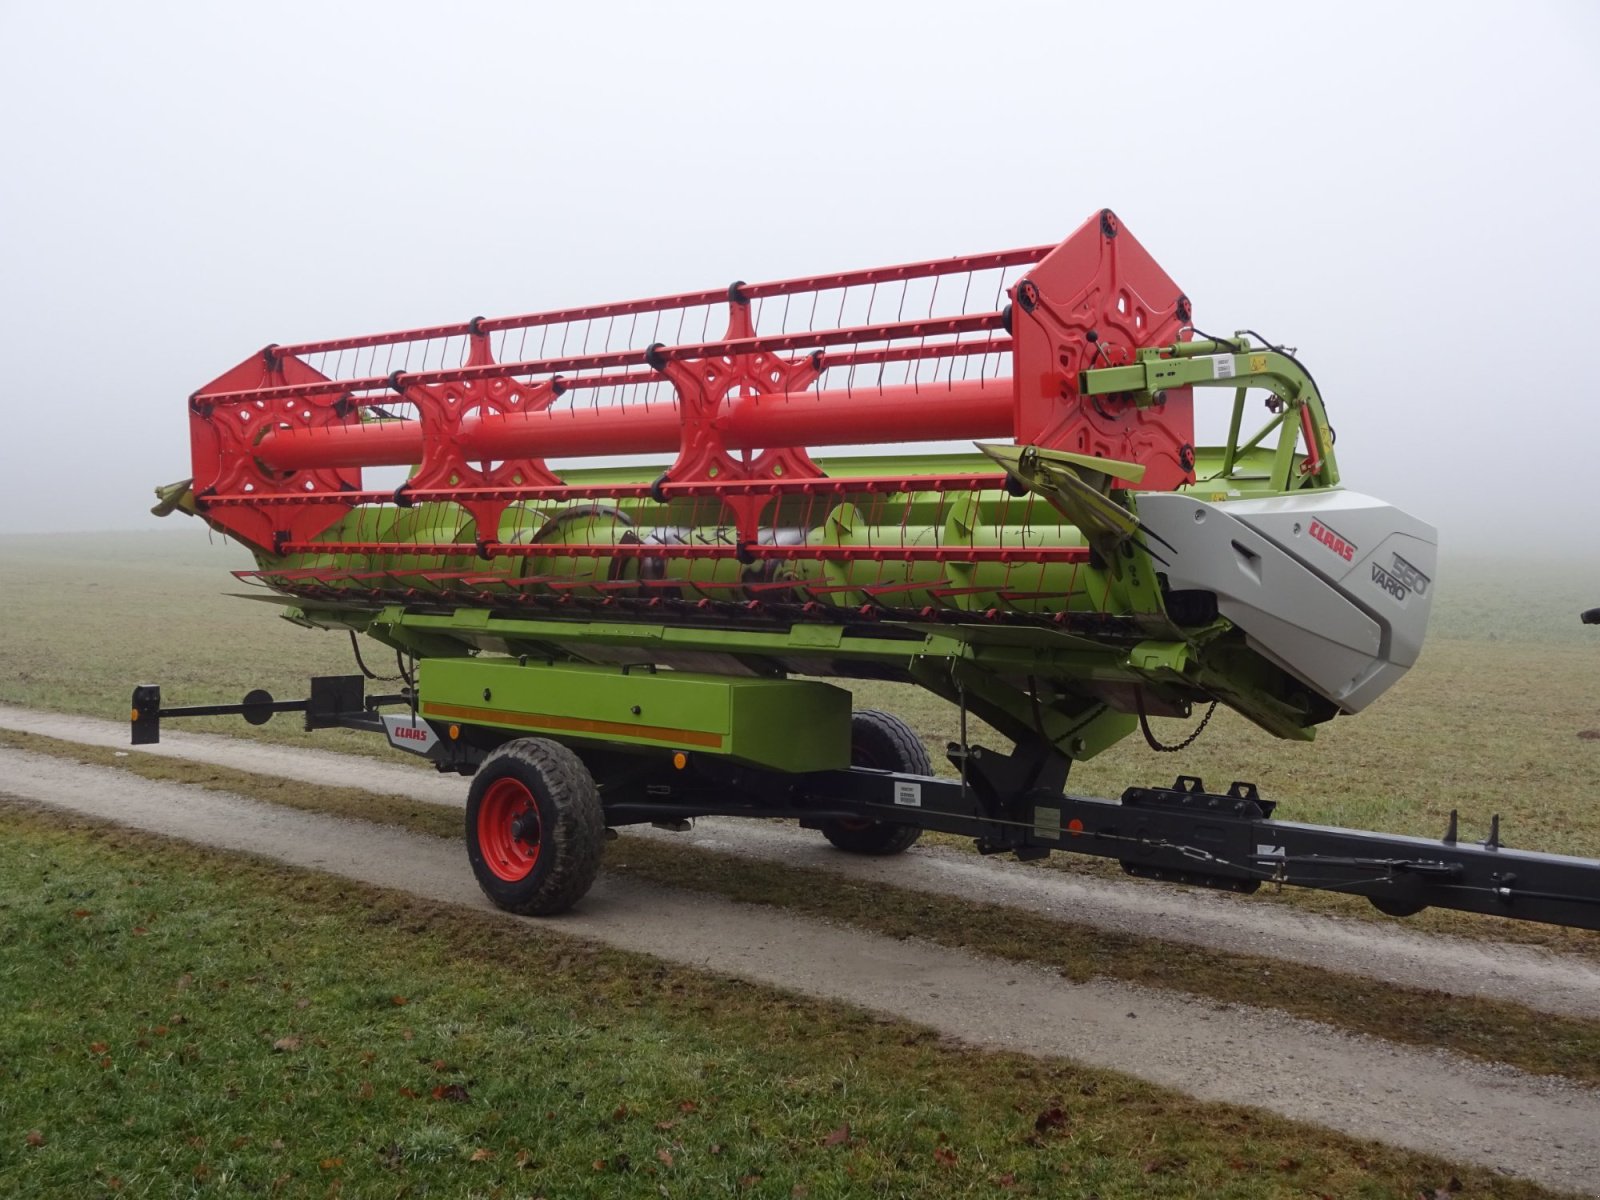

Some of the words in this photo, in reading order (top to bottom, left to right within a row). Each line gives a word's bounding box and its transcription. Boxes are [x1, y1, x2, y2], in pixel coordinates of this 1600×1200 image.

[1308, 521, 1354, 562] CLAAS
[1371, 565, 1406, 601] VARIO
[1391, 556, 1427, 595] 560
[395, 727, 427, 741] CLAAS
